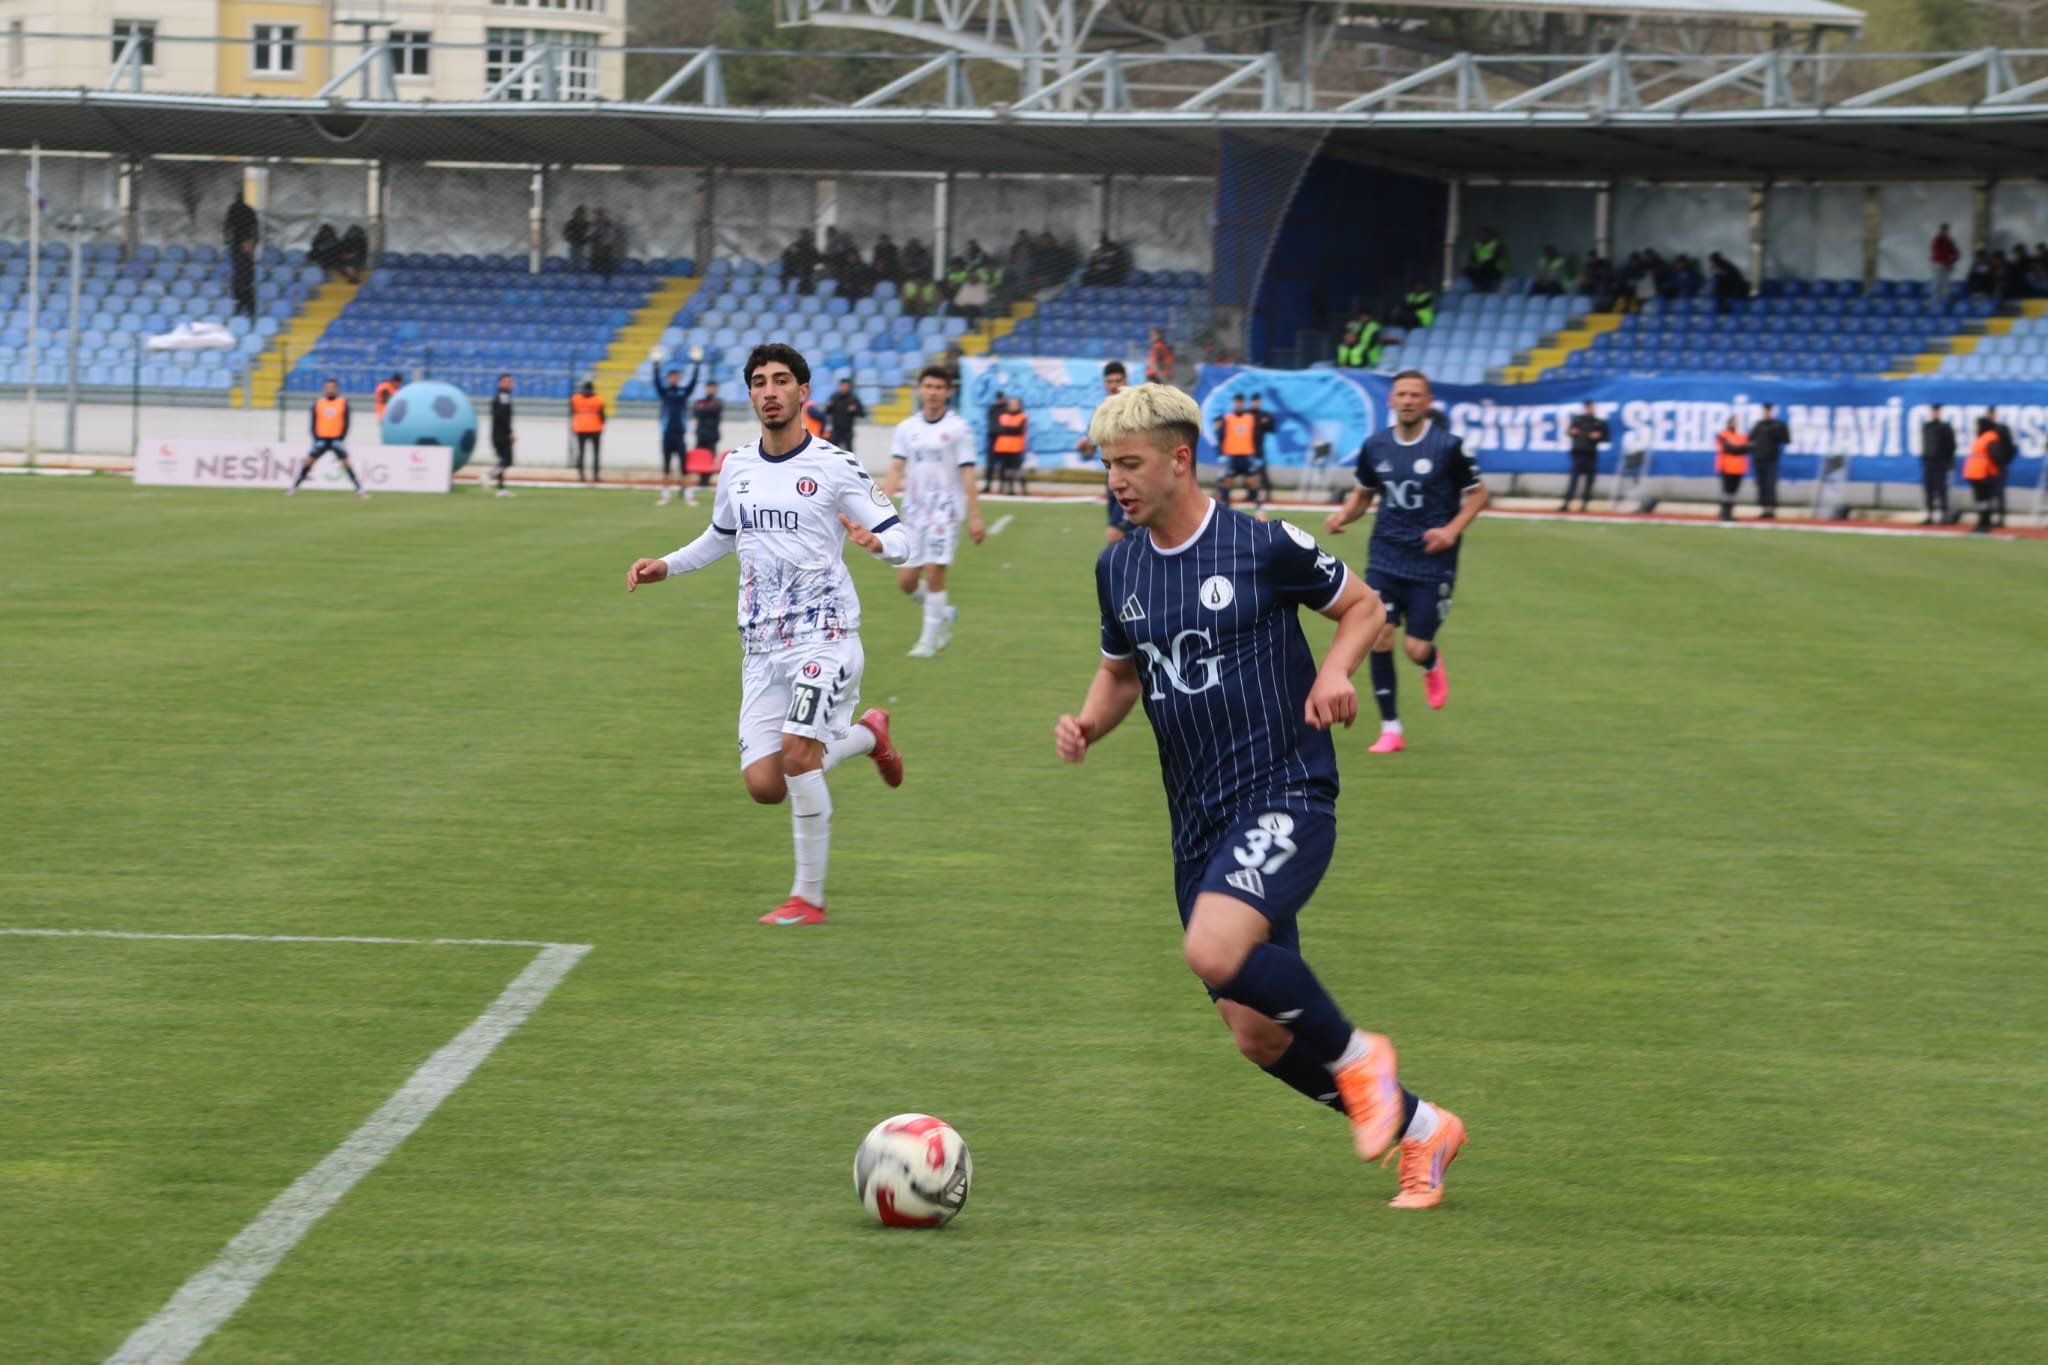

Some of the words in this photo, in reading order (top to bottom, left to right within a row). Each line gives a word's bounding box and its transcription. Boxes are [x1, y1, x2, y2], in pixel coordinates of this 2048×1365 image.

[1382, 480, 1424, 510] NG
[739, 503, 798, 530] Lima
[1137, 627, 1225, 700] NG
[1233, 828, 1298, 875] 37
